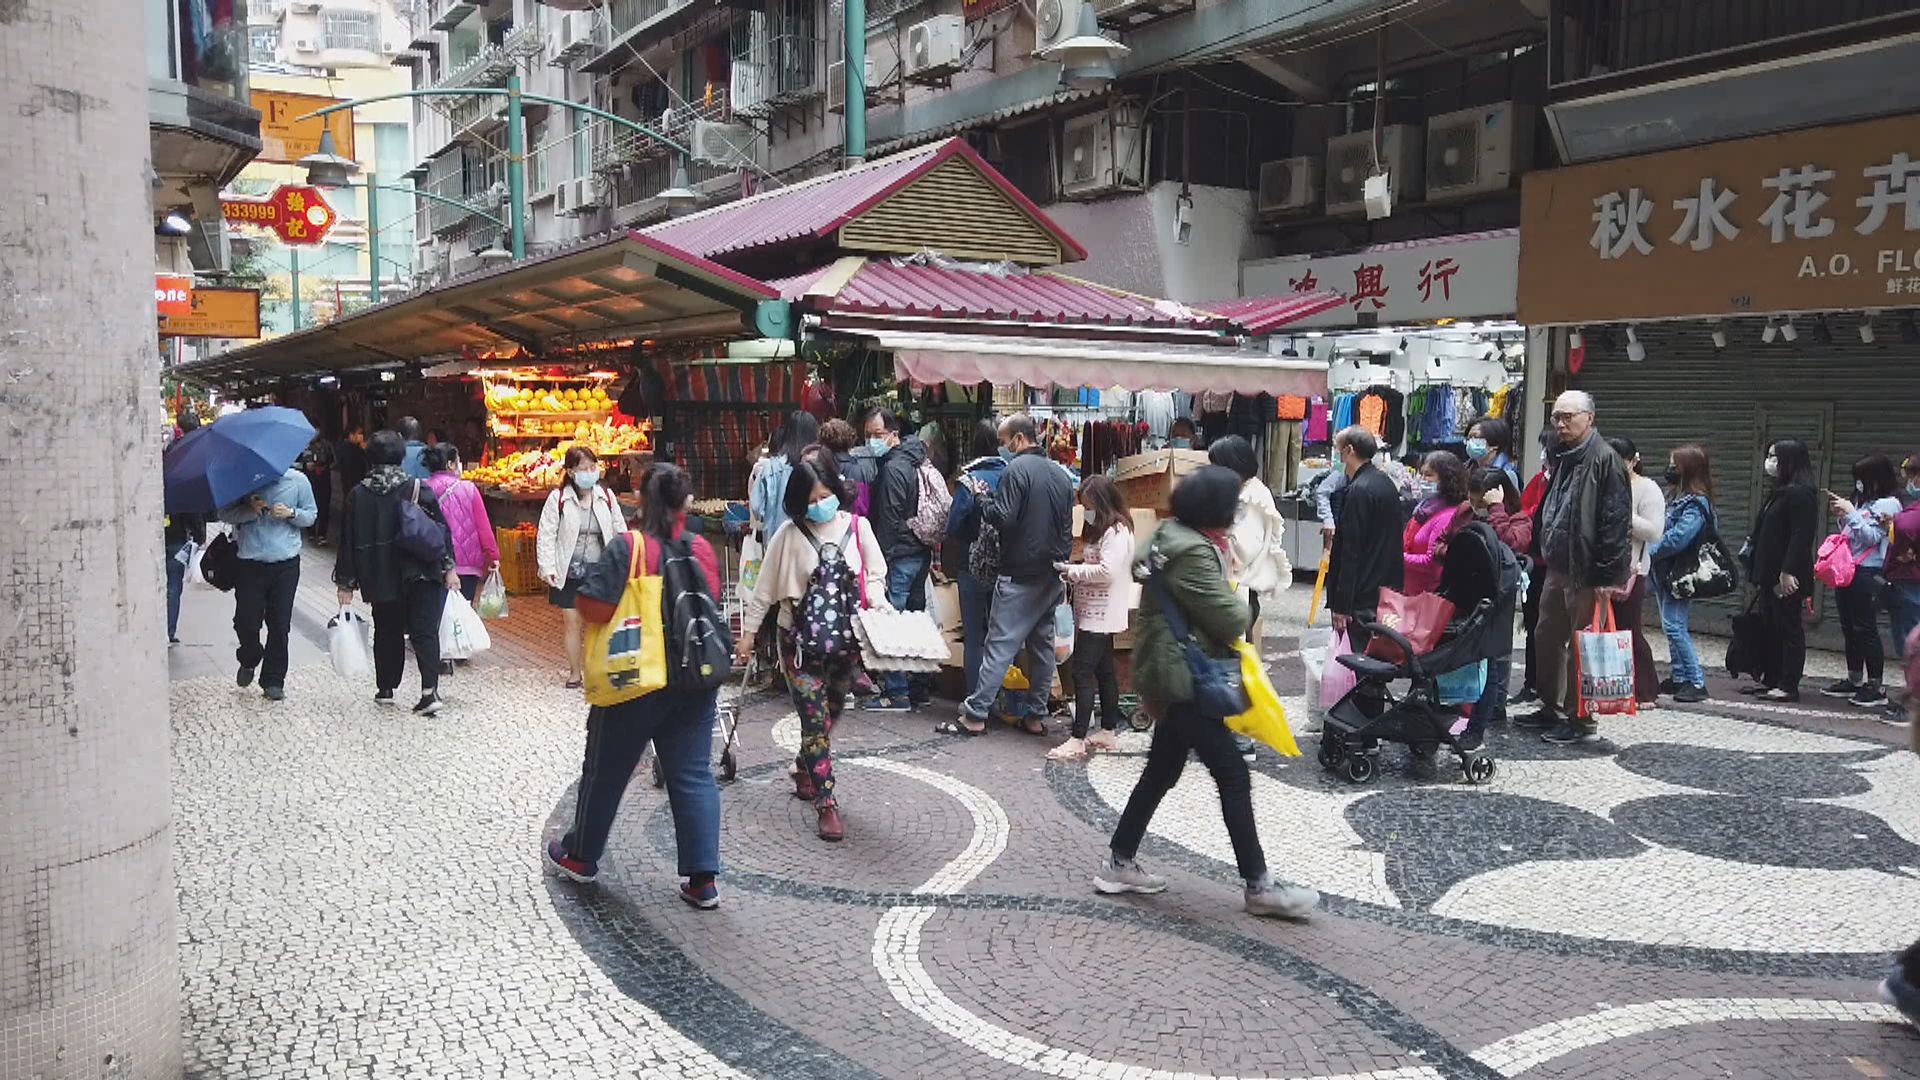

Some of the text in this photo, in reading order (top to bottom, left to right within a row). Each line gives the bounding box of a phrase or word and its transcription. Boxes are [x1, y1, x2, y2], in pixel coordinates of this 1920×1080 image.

[222, 202, 276, 220] 333999
[1589, 152, 1920, 260] 秋水花卉
[1797, 253, 1859, 278] A.O.
